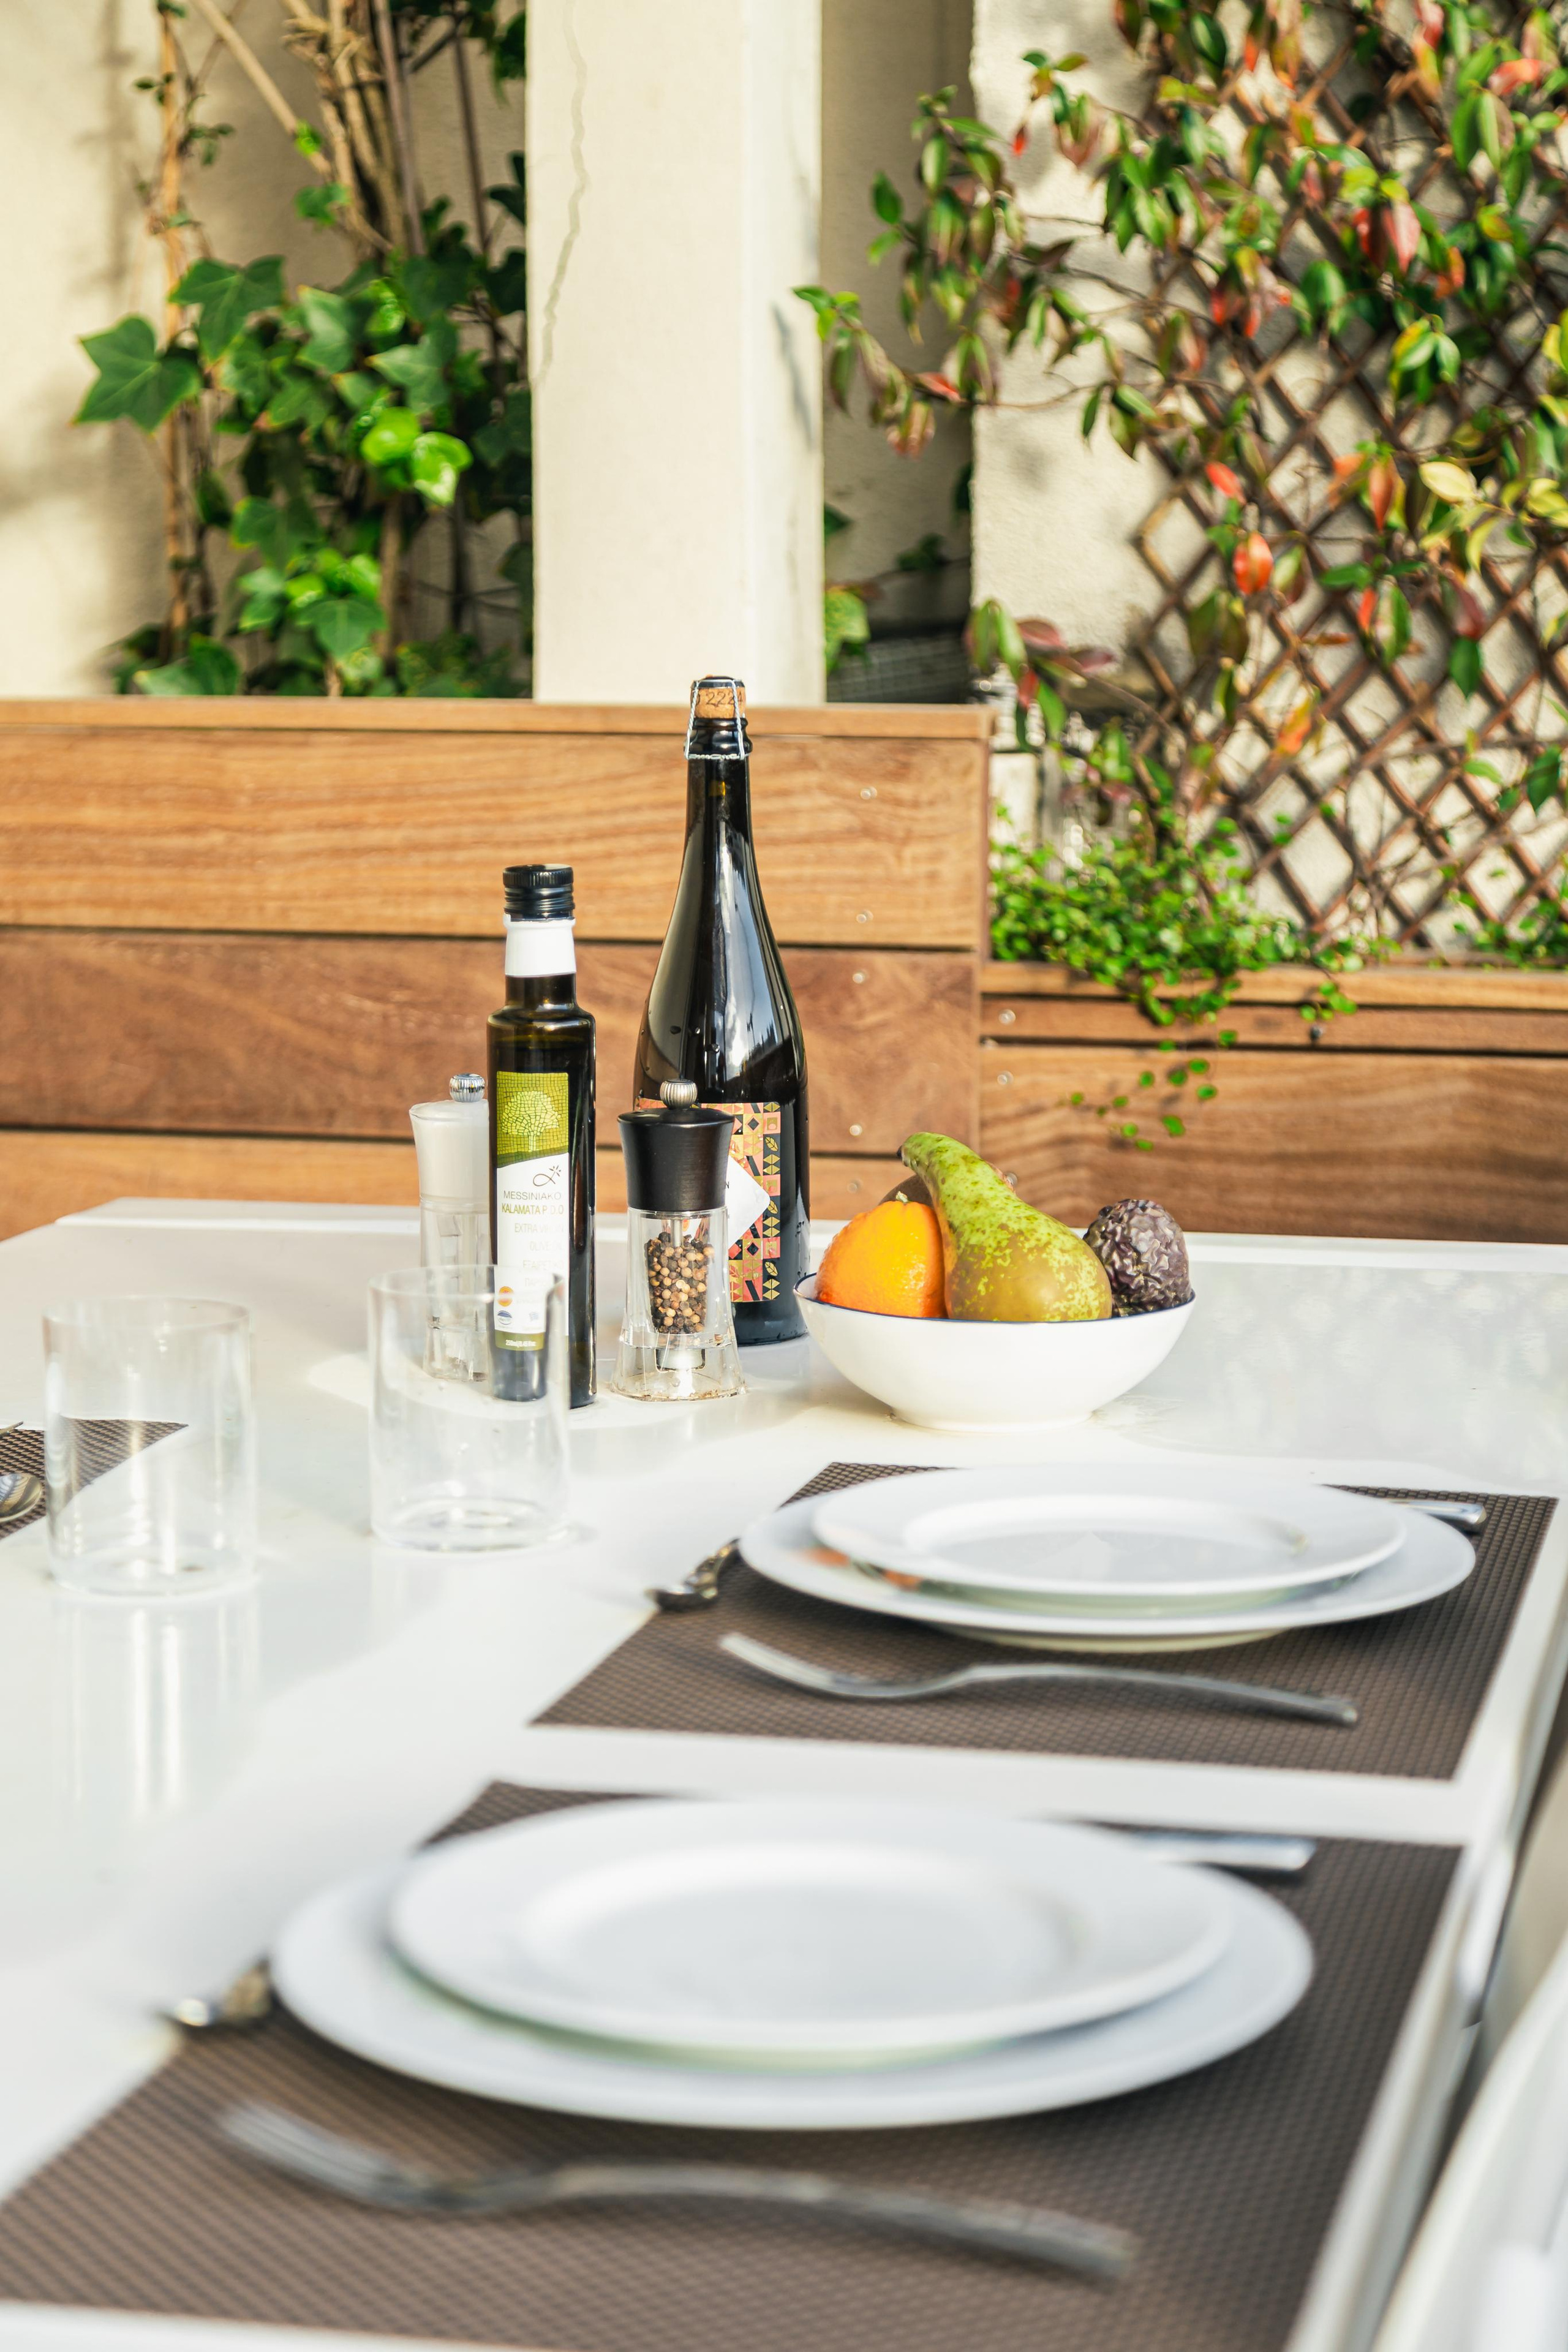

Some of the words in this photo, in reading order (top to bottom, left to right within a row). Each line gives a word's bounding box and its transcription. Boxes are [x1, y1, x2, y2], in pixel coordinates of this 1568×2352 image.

[503, 1190, 562, 1200] MESSINIAKO
[501, 1203, 540, 1215] KALAMATA
[542, 1205, 564, 1215] PD.O
[514, 1223, 538, 1233] EXTRA
[552, 1242, 564, 1251] IL
